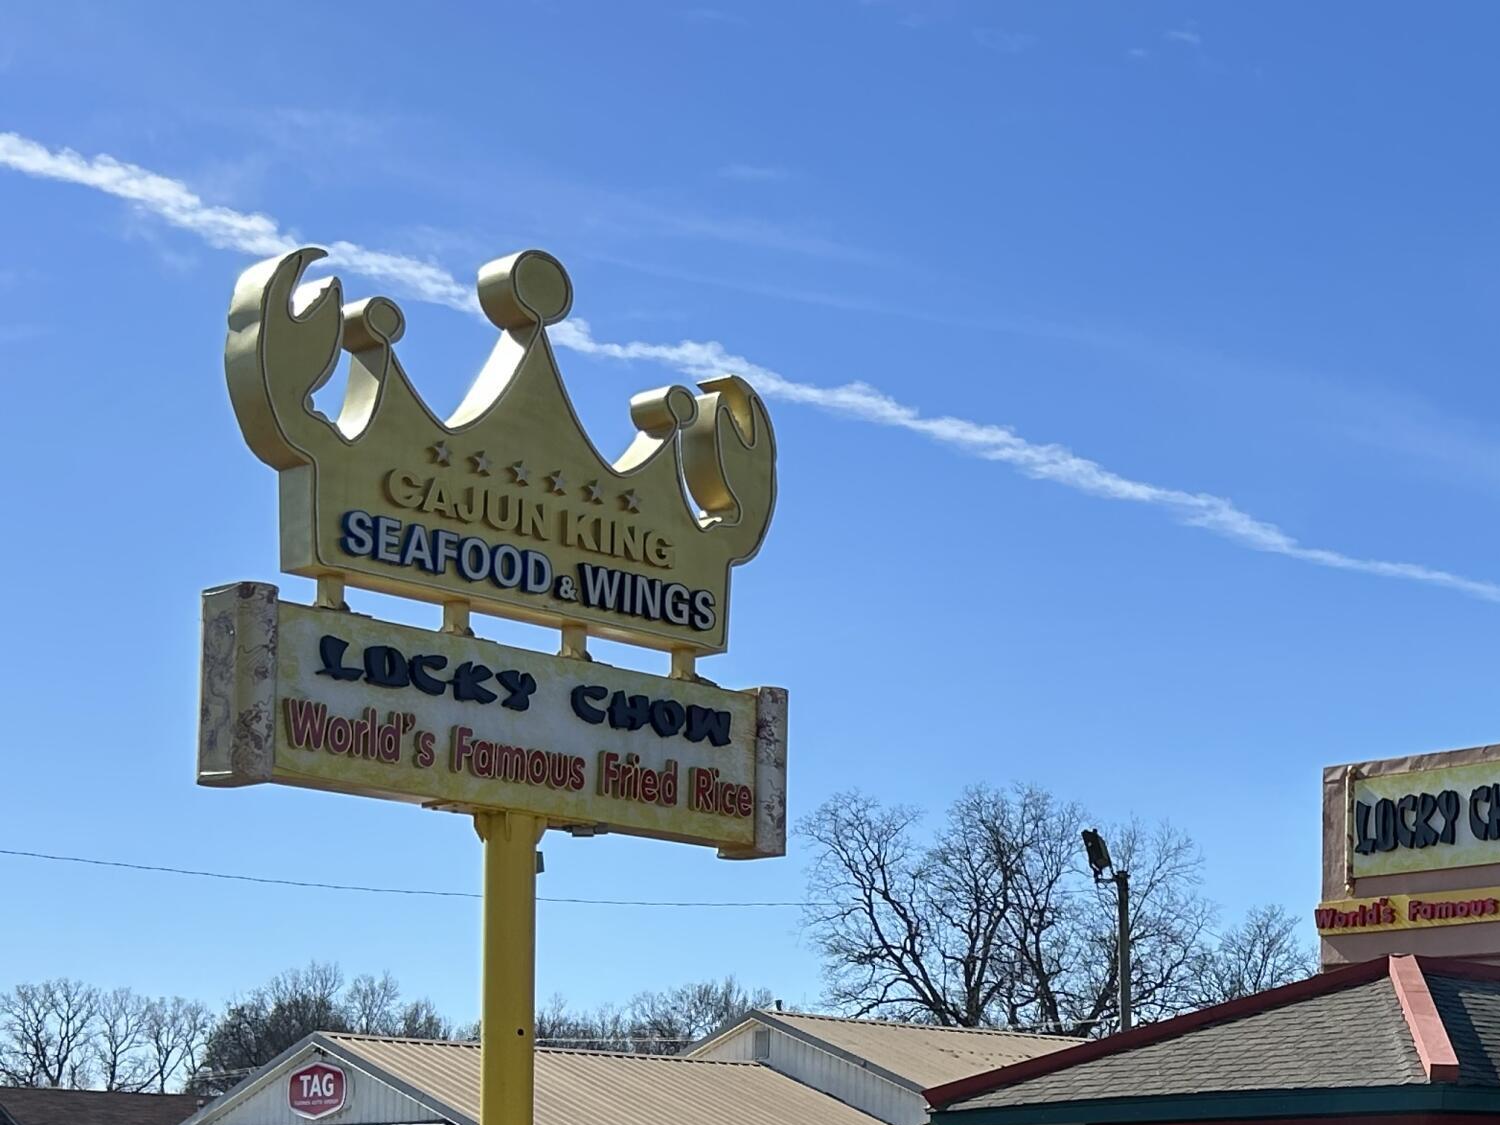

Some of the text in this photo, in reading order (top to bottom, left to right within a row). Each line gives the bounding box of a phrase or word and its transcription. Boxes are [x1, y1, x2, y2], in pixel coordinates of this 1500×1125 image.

[385, 468, 676, 569] CAJUN KING
[342, 510, 717, 632] SEAFOOD & WINGS
[570, 684, 732, 747] CHOW
[283, 697, 754, 818] World's Famous Fried Rice
[1314, 897, 1397, 930] World's
[1407, 897, 1500, 922] Famous
[300, 1073, 335, 1098] TAG
